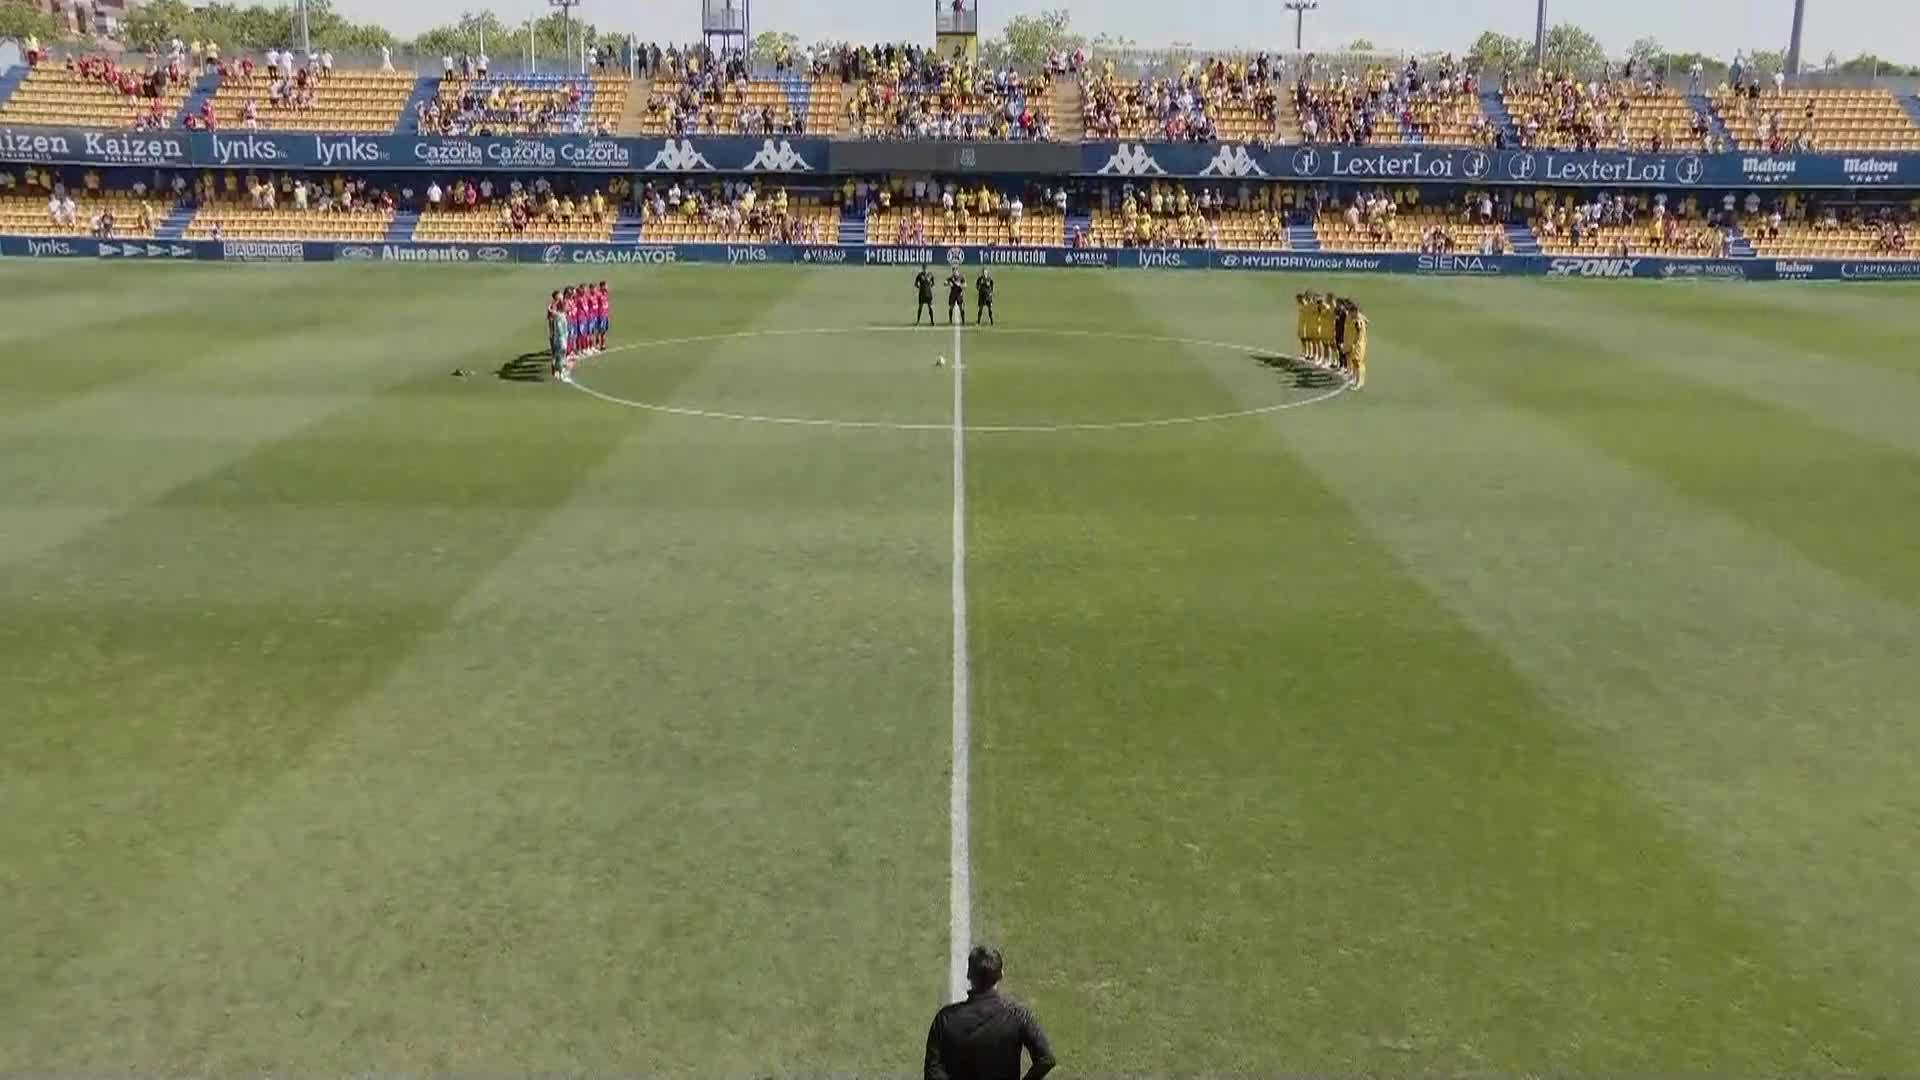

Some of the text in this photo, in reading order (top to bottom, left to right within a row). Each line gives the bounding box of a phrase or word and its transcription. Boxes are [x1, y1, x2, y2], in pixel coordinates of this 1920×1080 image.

[0, 129, 70, 153] izen
[84, 132, 183, 156] Kaizen
[213, 134, 276, 163] lynks
[316, 136, 379, 165] lynks
[415, 143, 482, 159] Cazorla
[488, 144, 555, 160] Cazorla
[561, 144, 629, 160] Cazorla
[1331, 150, 1453, 177] LexterLoi
[1546, 155, 1666, 181] LexterLoi
[1743, 158, 1796, 173] Mahou
[1843, 158, 1897, 173] Mahou
[28, 240, 70, 256] lynks
[224, 243, 303, 256] BAUHAUS
[382, 245, 470, 261] Almoauto
[727, 245, 767, 264] lynks
[877, 248, 933, 263] FEDERACIÓN
[573, 250, 677, 263] CASAMAYOR
[991, 249, 1047, 264] FEDERACIÓN
[1138, 248, 1181, 269] lynks
[1242, 256, 1303, 267] HYUNDAI
[1345, 258, 1380, 269] Motor
[1418, 255, 1484, 270] SIENA
[1546, 258, 1640, 277] SPONIX
[1775, 261, 1813, 272] Mahou
